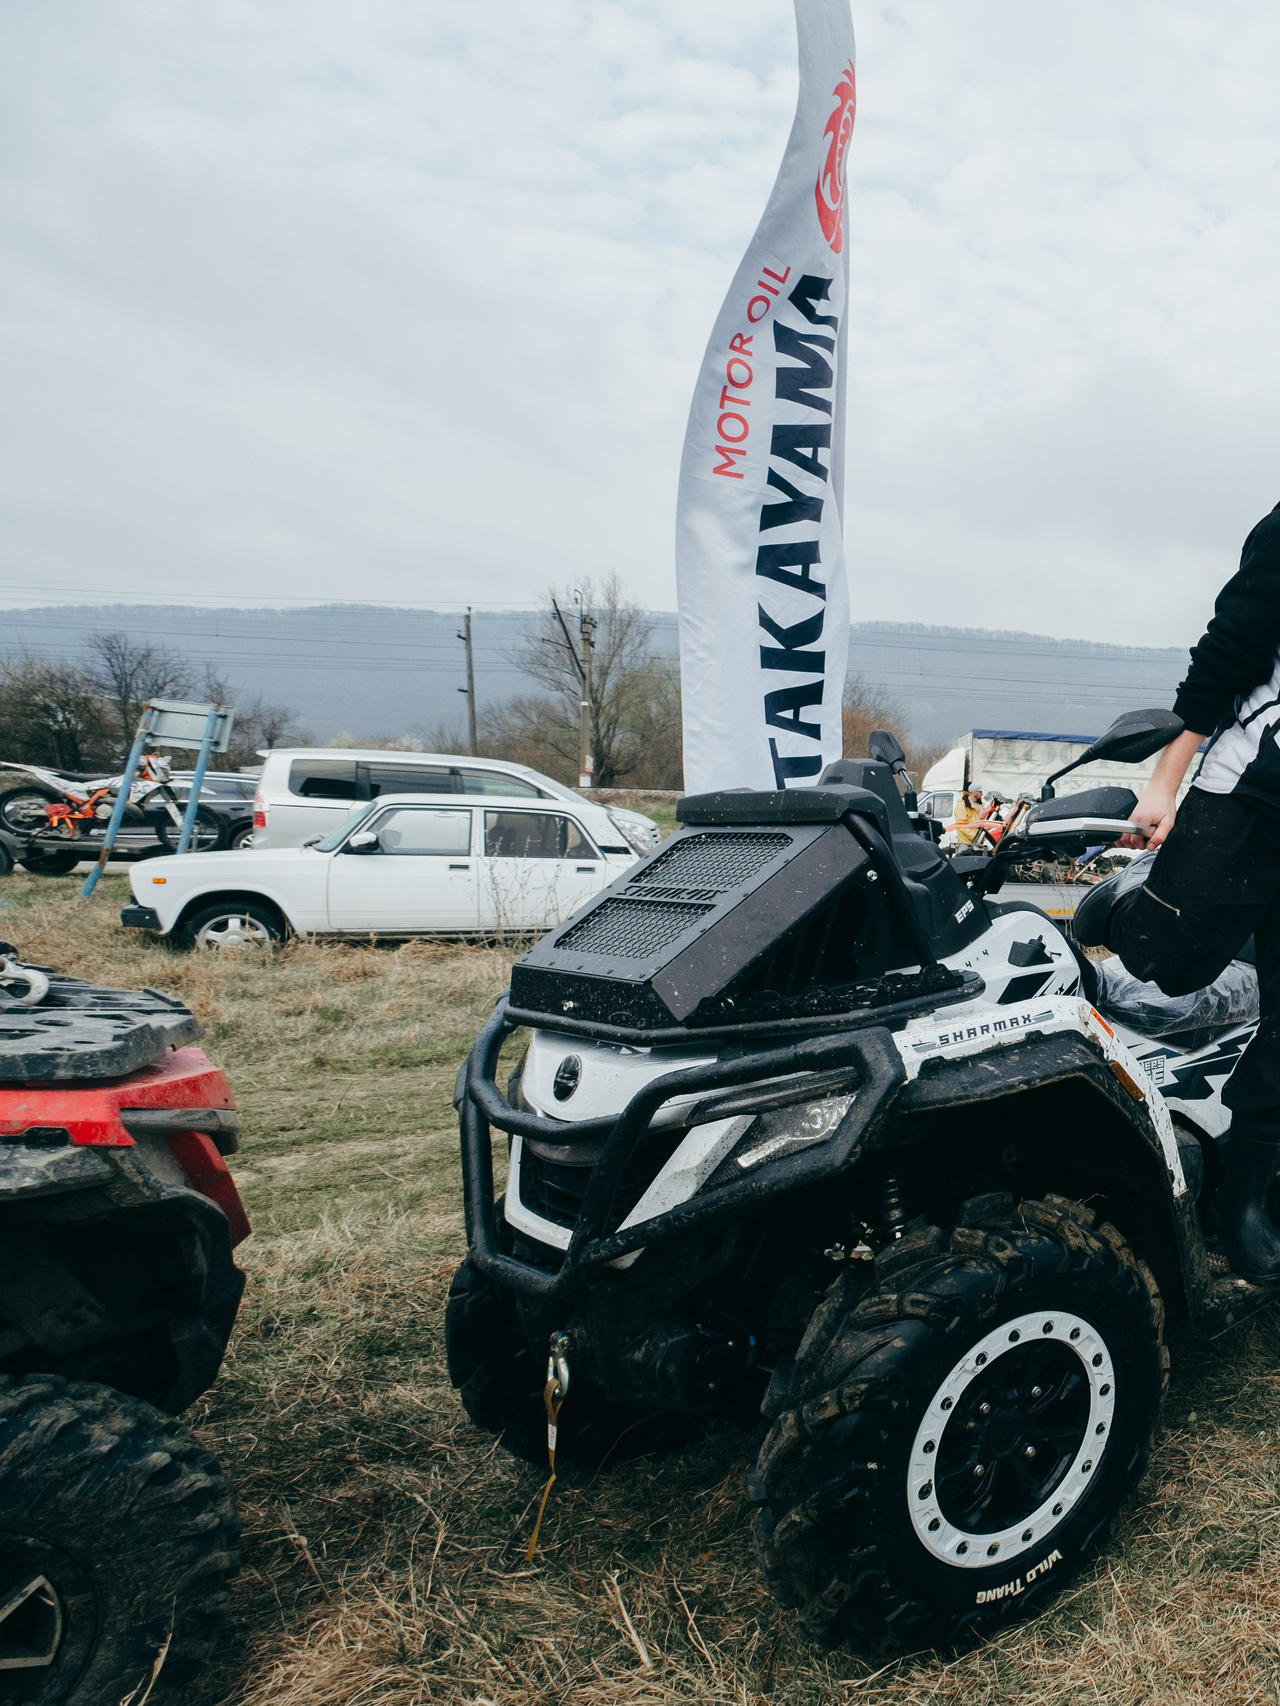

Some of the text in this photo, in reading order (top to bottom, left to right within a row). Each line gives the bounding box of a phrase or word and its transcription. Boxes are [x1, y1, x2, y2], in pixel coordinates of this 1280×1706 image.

[713, 266, 791, 479] MOTOR OIL
[756, 274, 838, 790] TAKAYAMA
[954, 899, 975, 924] EPS
[938, 1014, 1034, 1045] SHARMAX
[975, 1549, 1063, 1604] WILD THANG
